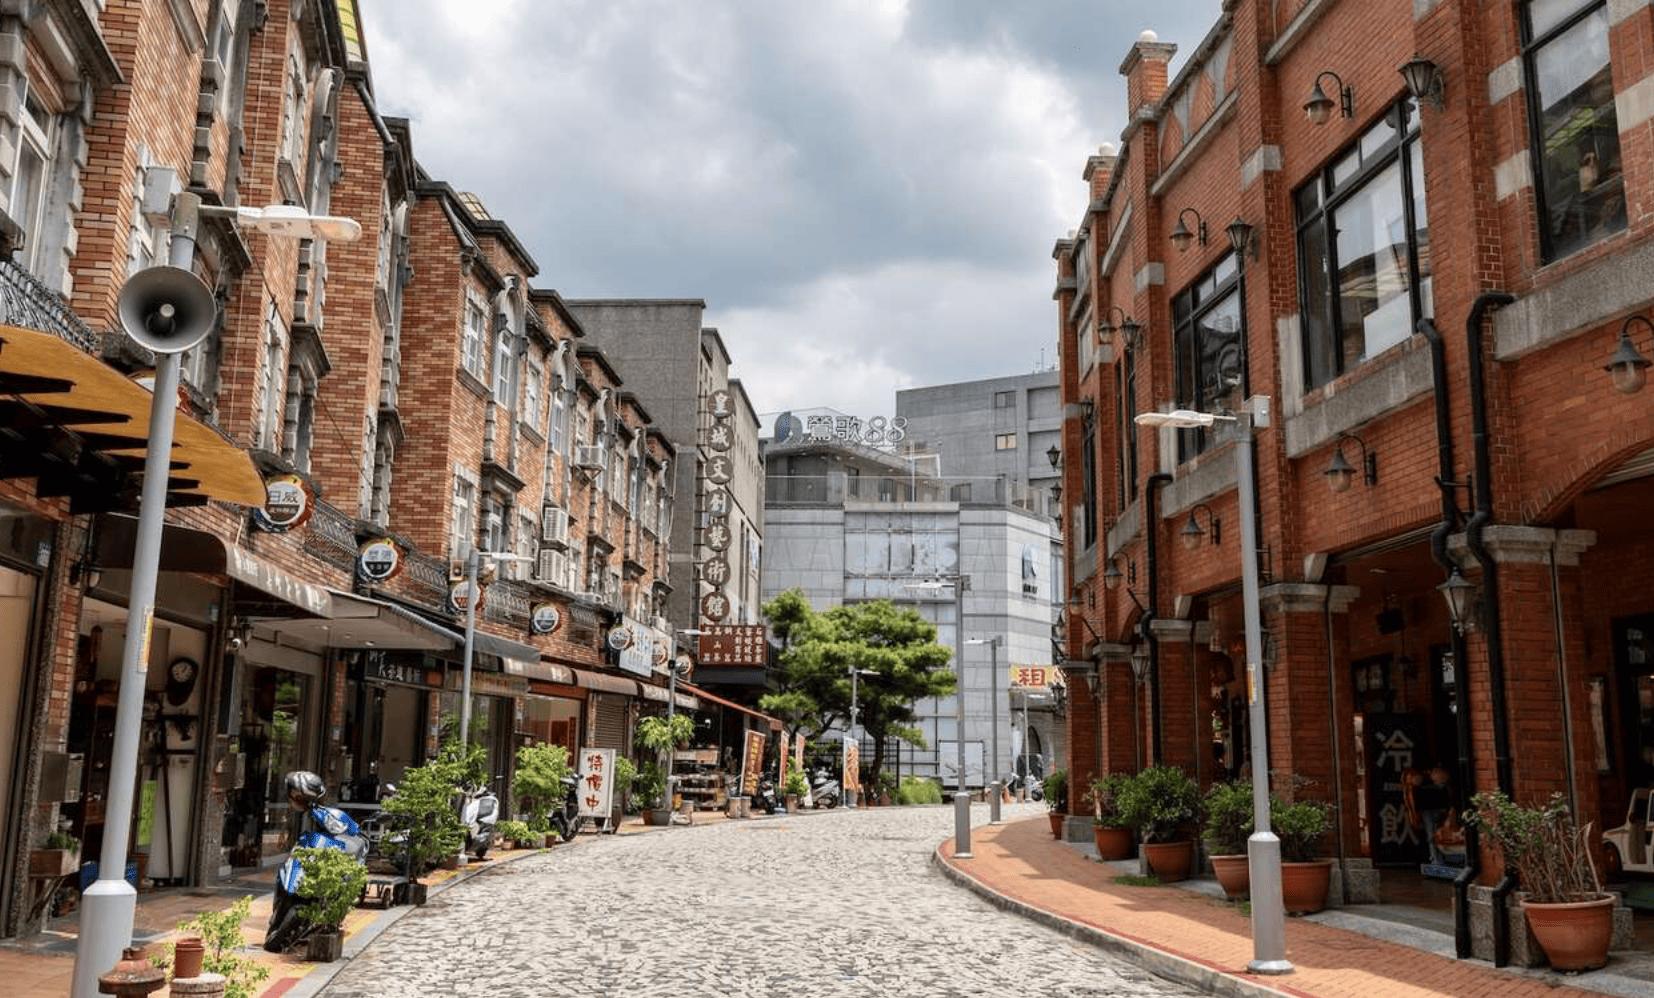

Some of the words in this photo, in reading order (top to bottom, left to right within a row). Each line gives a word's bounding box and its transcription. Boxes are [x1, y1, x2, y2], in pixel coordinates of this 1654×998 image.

[706, 393, 729, 617] 皇城文創藝術館
[1018, 668, 1046, 686] 租
[585, 754, 603, 812] 特價中
